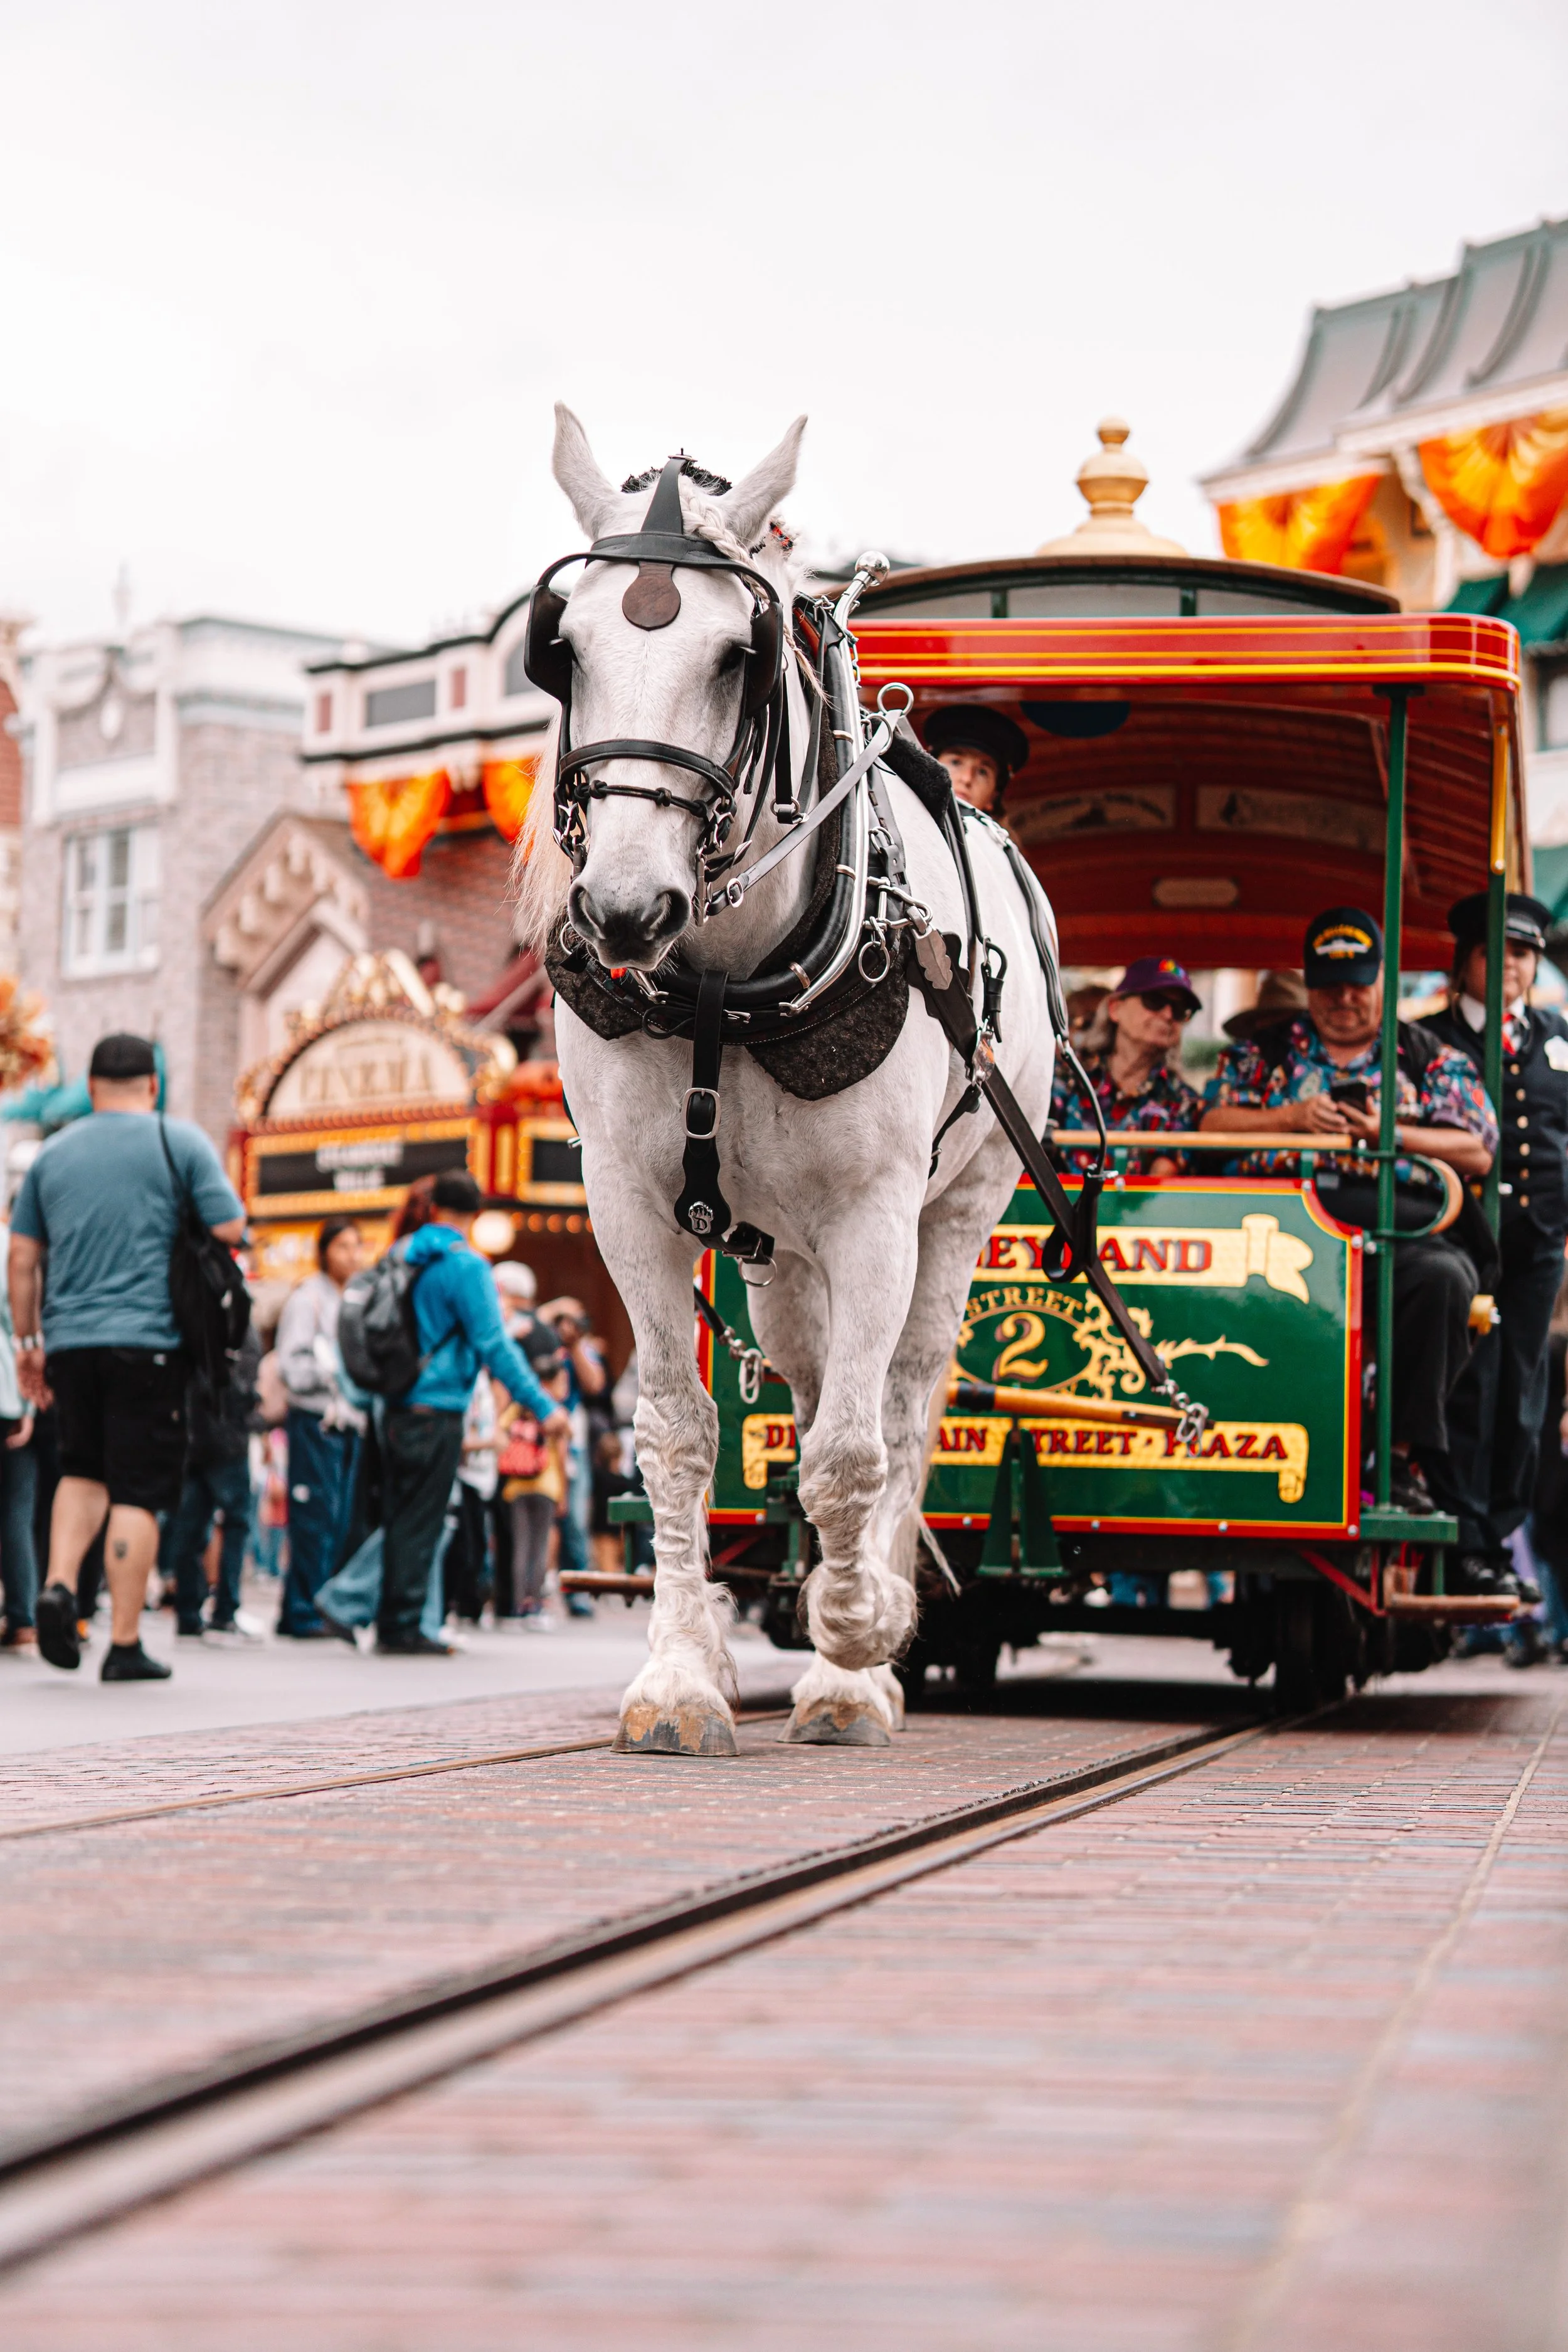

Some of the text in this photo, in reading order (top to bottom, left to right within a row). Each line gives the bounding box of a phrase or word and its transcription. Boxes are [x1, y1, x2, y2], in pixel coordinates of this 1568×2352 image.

[977, 1236, 1212, 1273] EYAND
[966, 1286, 1083, 1317] STREET
[992, 1311, 1049, 1382] 2
[937, 1426, 987, 1453] AIN
[1029, 1429, 1137, 1455] TREET
